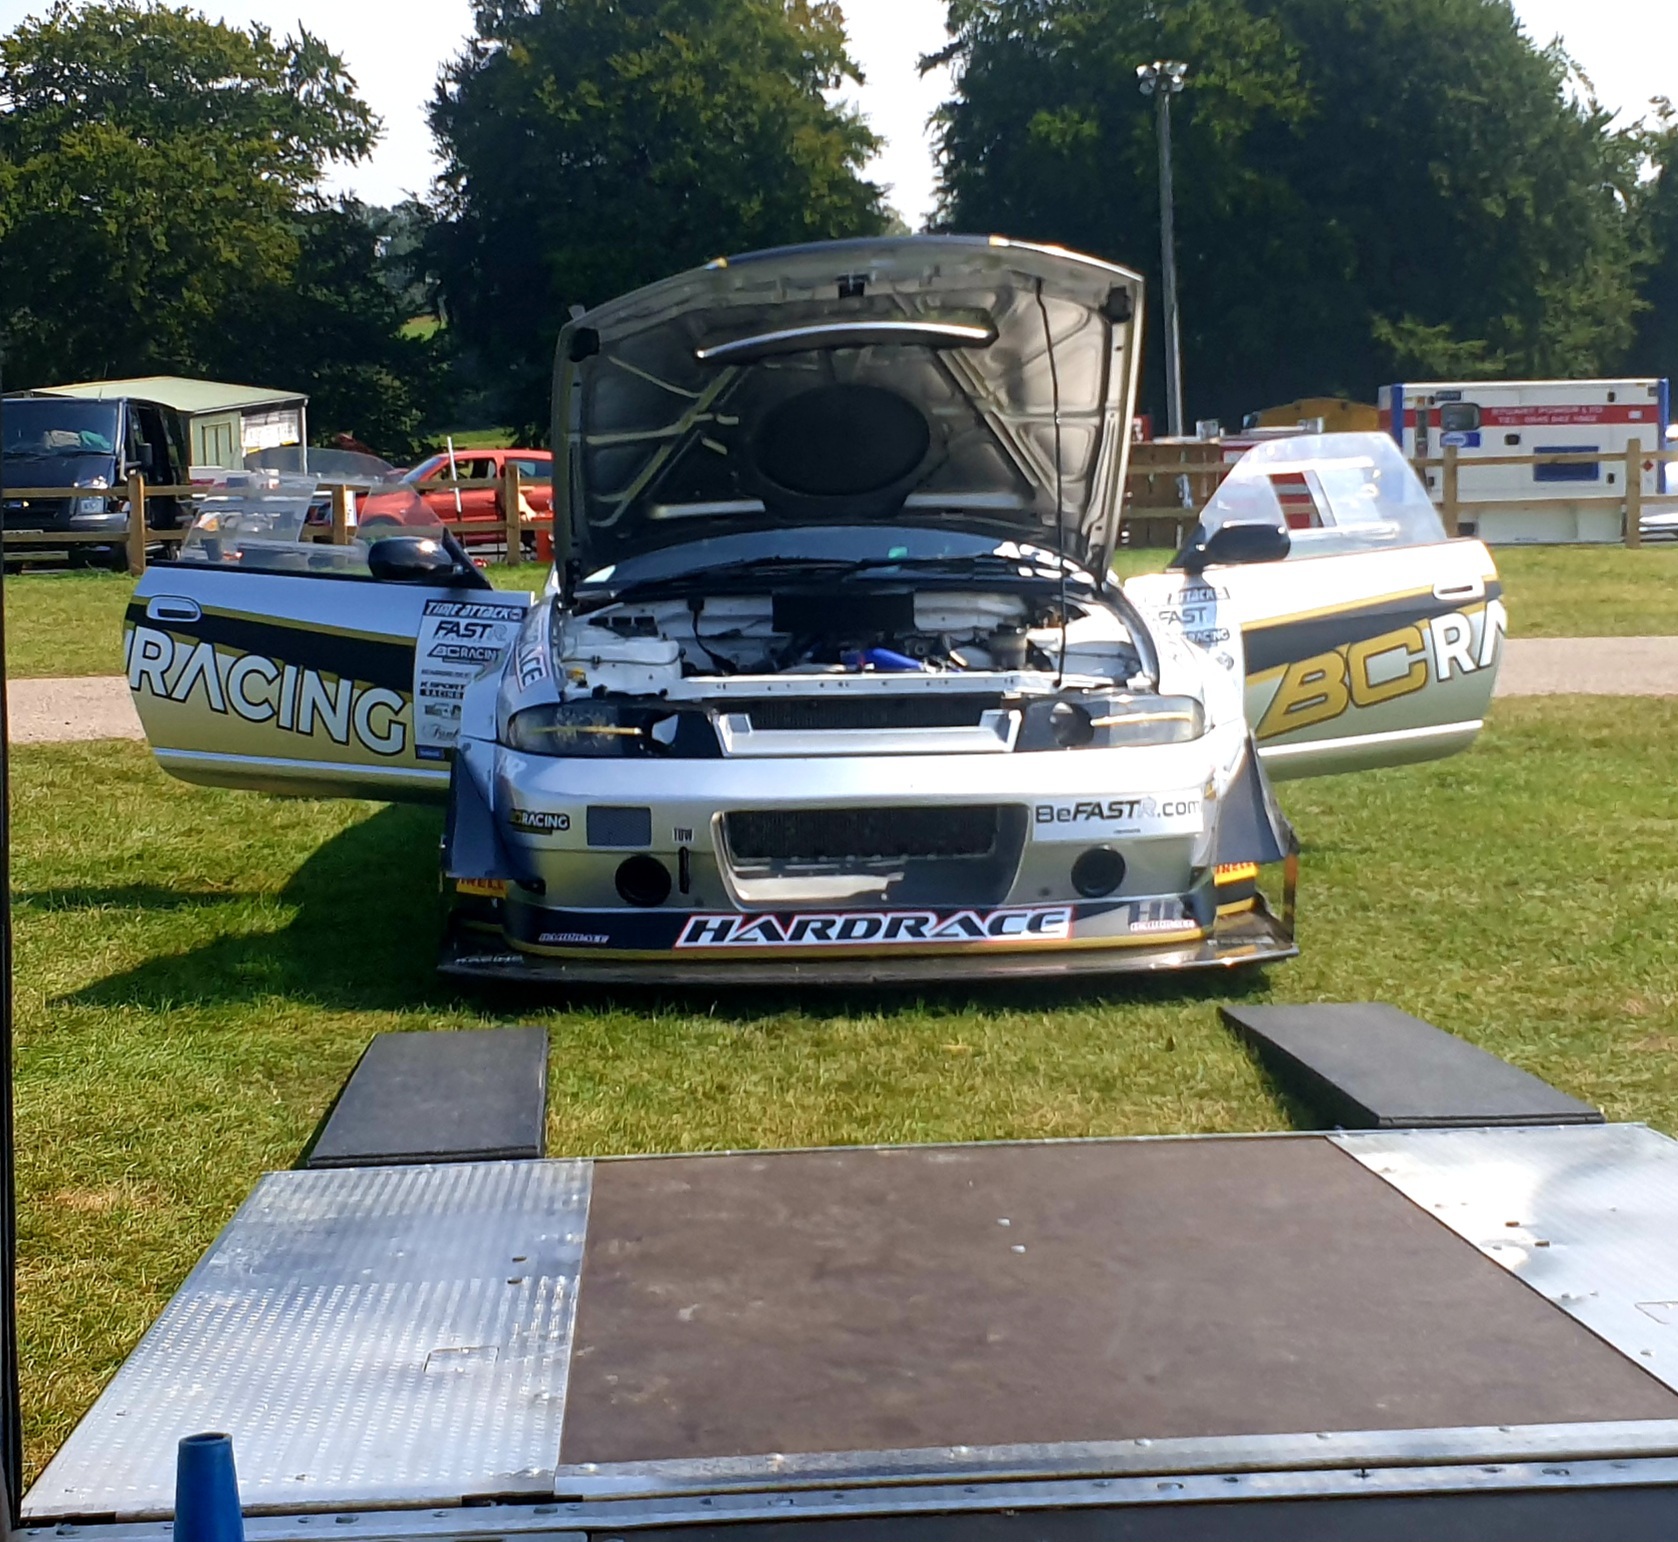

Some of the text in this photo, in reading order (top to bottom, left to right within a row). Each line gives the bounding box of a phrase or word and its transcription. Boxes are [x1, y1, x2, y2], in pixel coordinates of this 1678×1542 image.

[460, 647, 498, 661] RACIN
[128, 625, 406, 756] RACING
[673, 828, 693, 841] TOW
[683, 910, 1068, 943] HARDRACE
